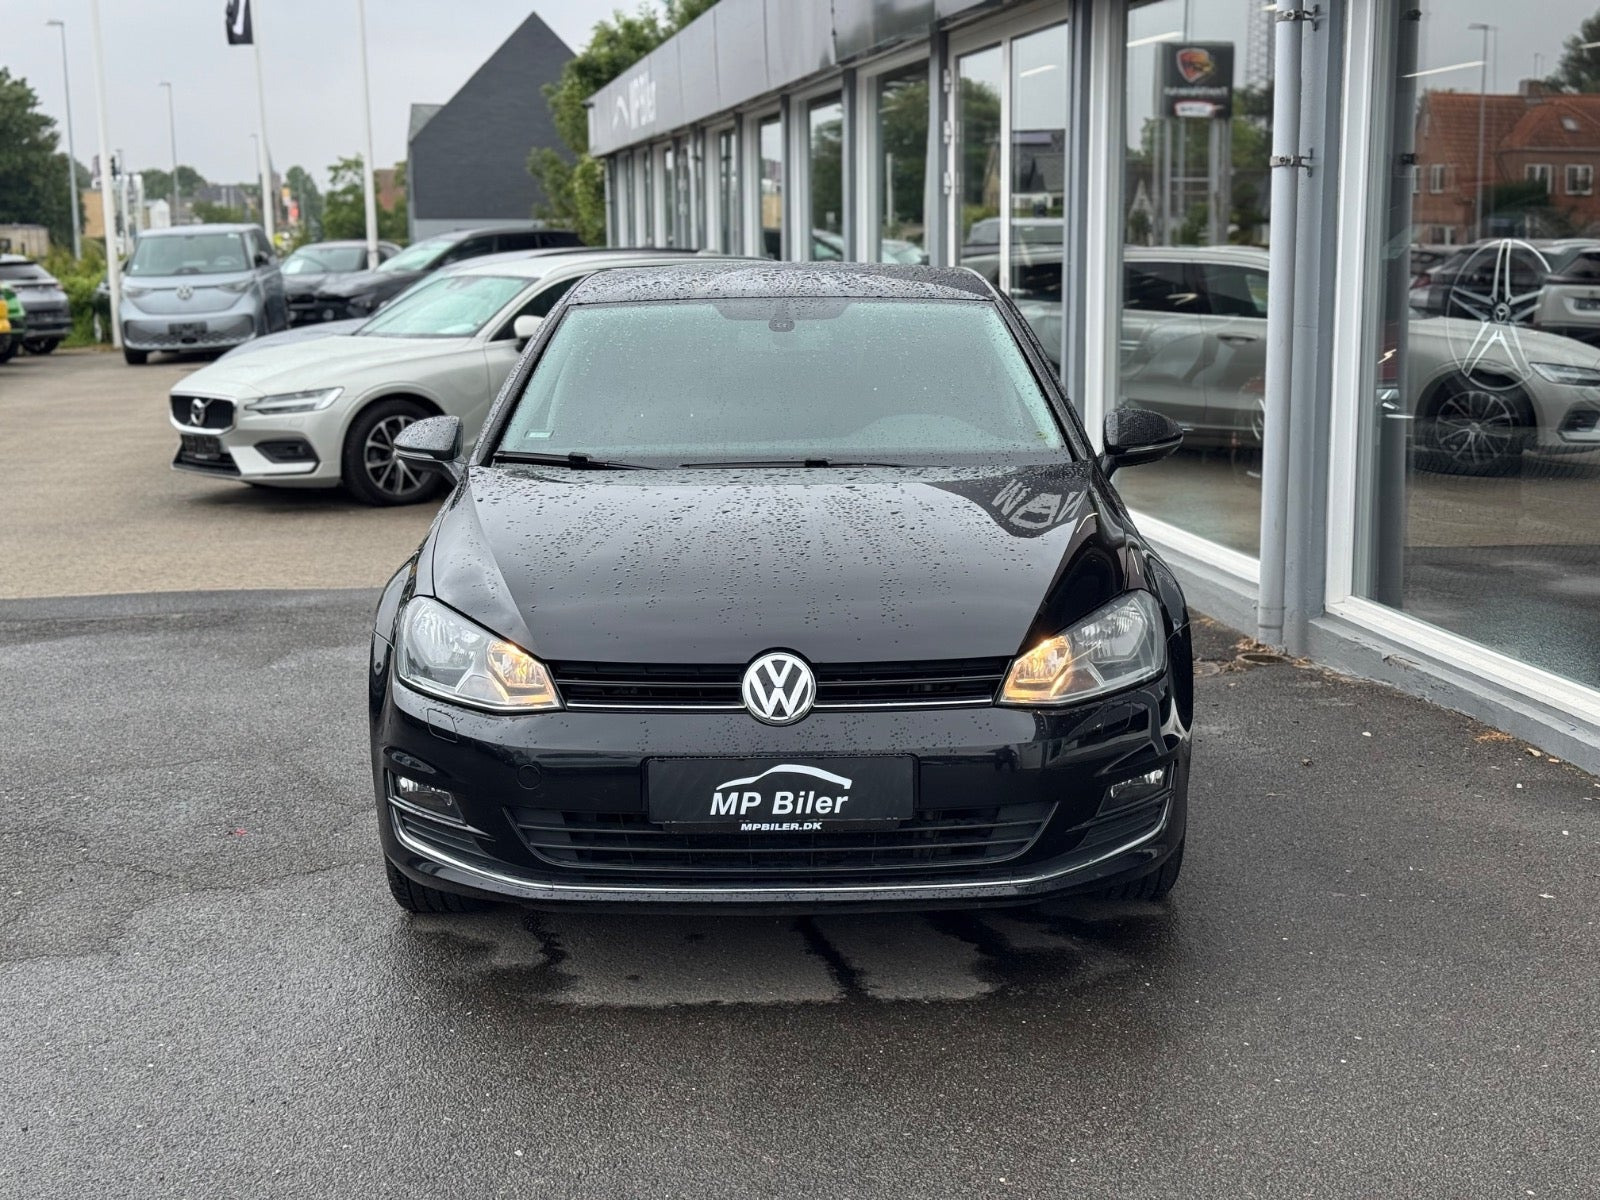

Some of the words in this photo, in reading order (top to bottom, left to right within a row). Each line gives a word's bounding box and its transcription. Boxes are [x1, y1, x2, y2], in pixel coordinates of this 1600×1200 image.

[709, 791, 762, 816] MP
[771, 790, 849, 815] Biler
[740, 821, 823, 831] MPBILER.DK
